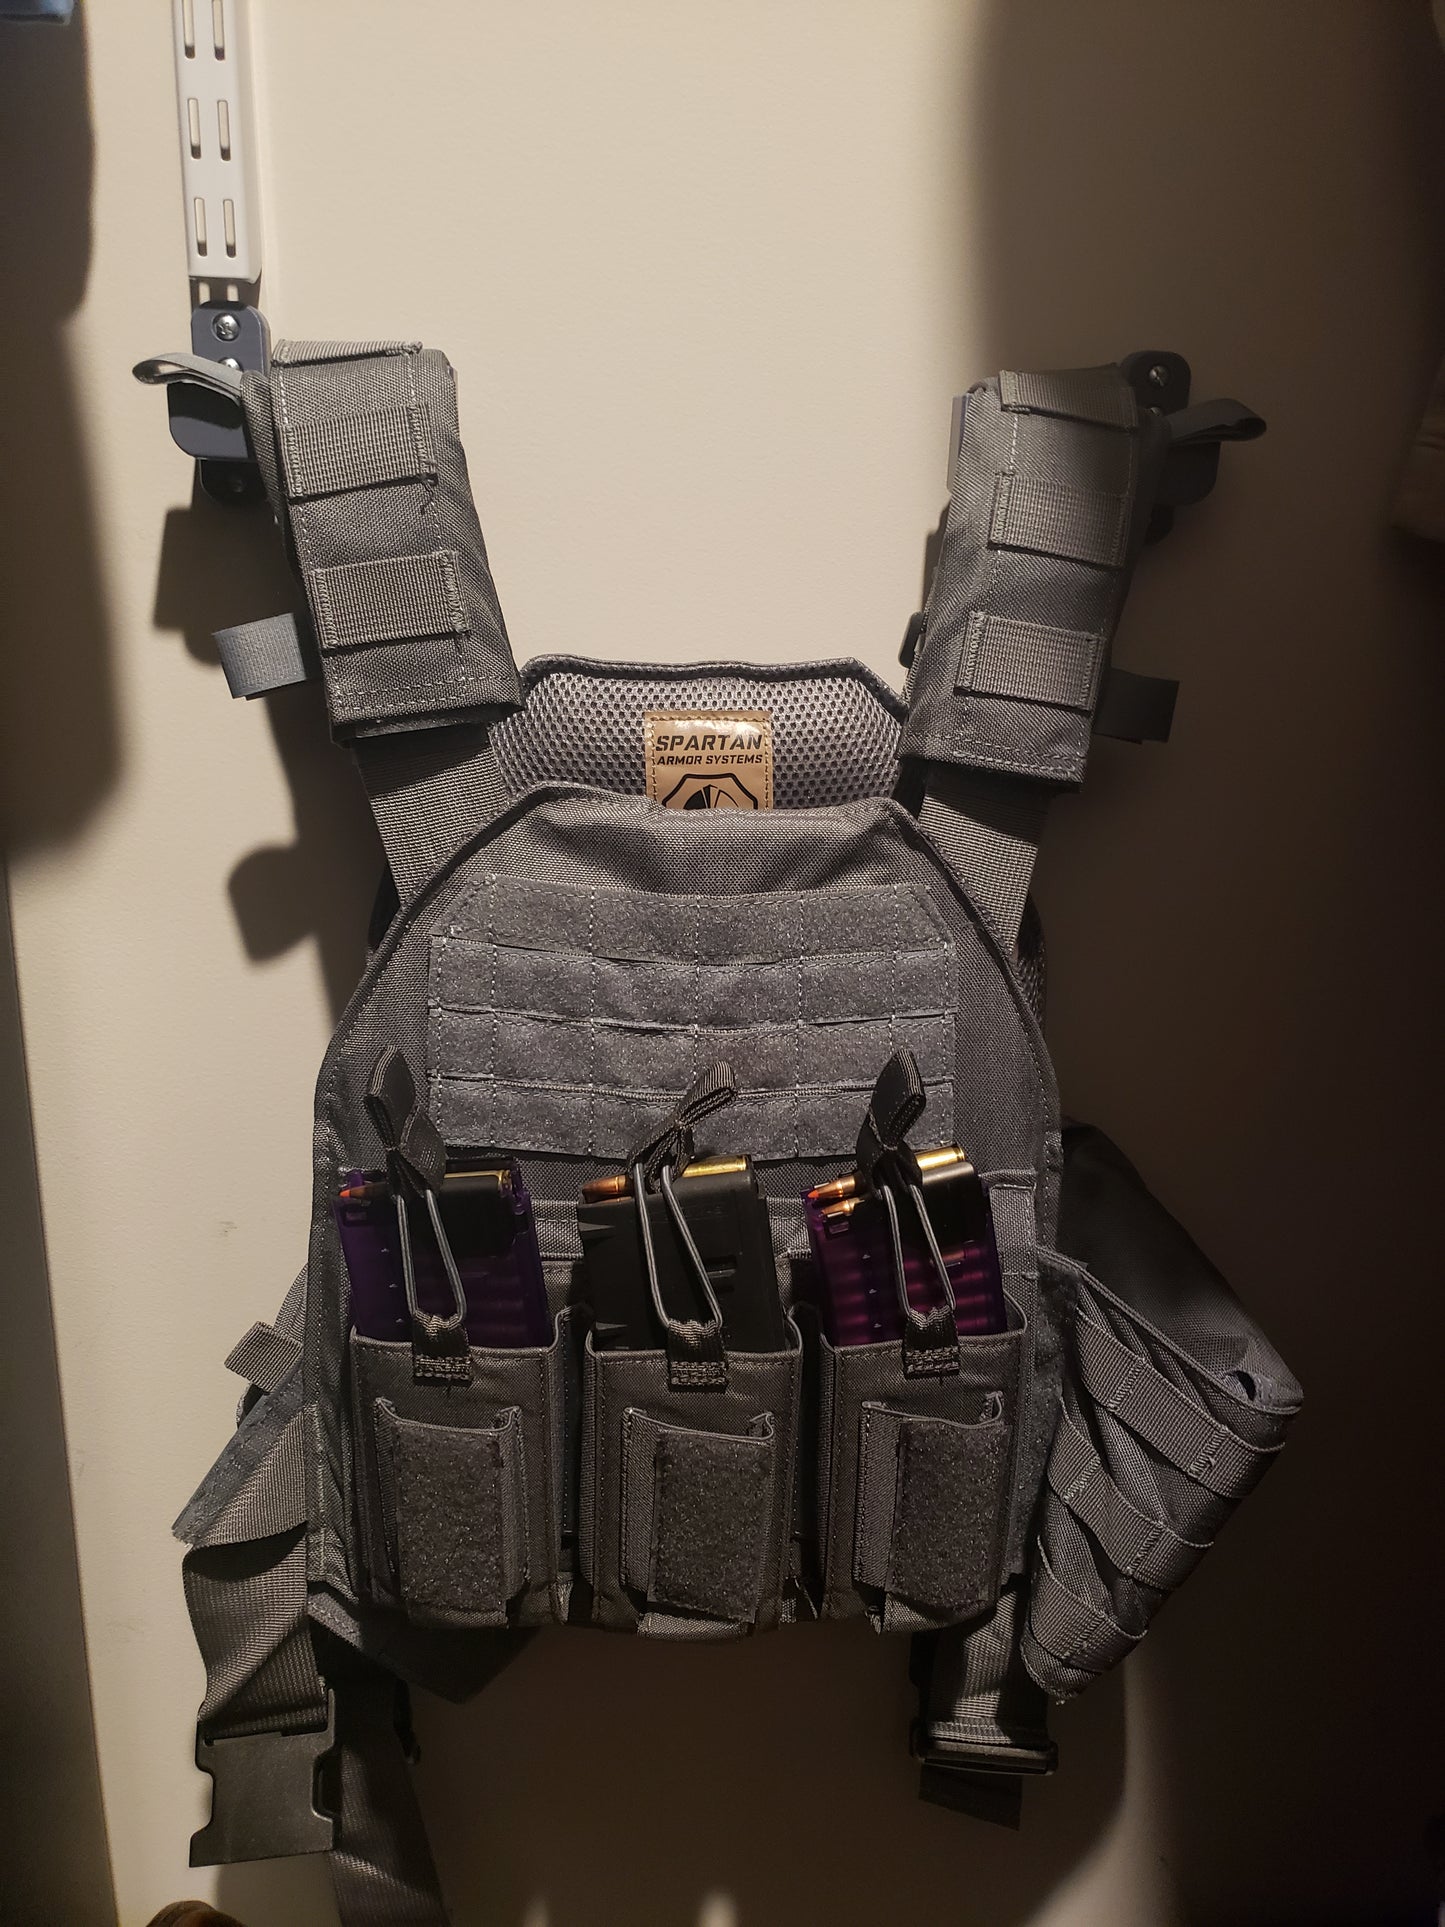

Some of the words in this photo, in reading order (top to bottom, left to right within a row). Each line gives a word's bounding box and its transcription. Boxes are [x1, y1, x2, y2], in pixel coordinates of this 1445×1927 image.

[655, 734, 763, 751] SPARTAN
[656, 755, 702, 766] ARMOR
[705, 754, 763, 765] SYSTEMS
